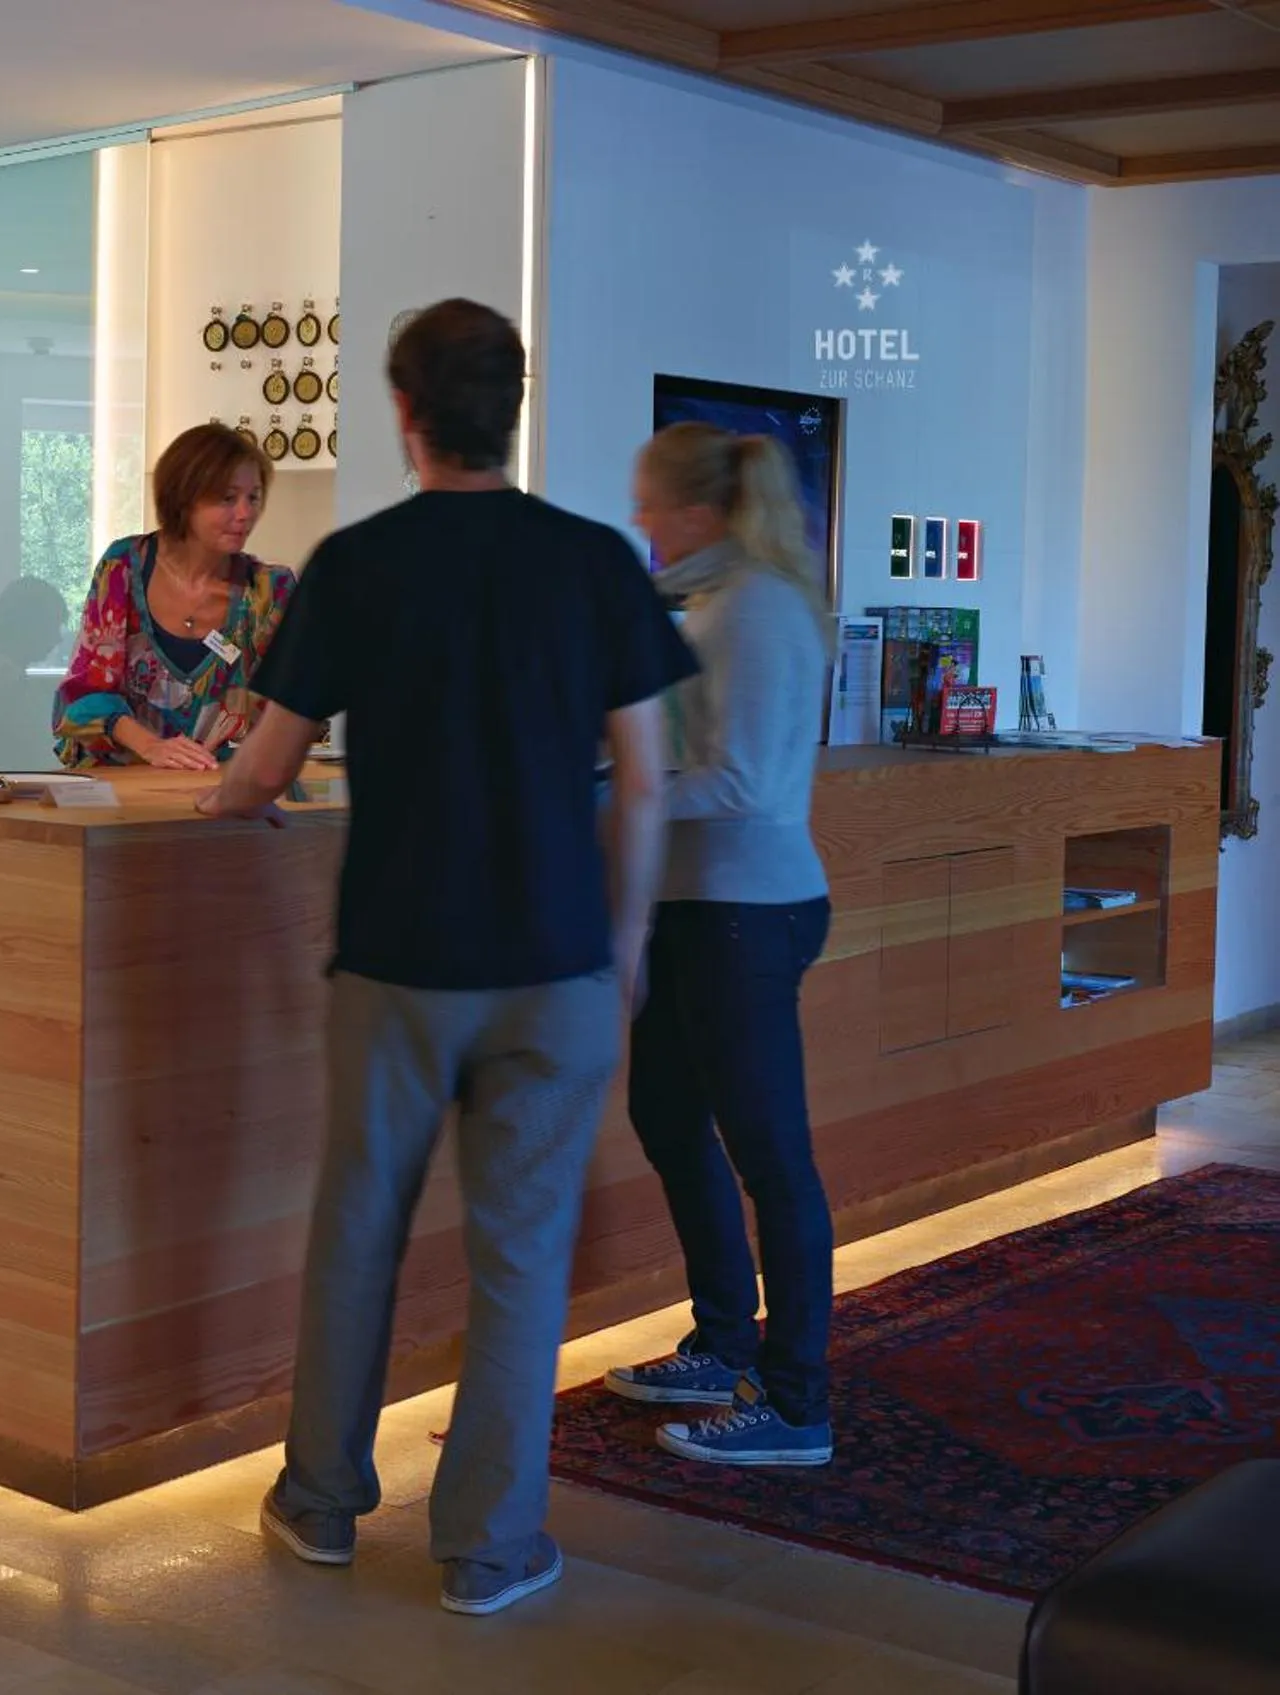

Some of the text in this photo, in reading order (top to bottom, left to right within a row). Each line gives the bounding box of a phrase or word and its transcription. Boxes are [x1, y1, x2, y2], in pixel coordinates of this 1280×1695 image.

[814, 328, 920, 361] HOTEL
[820, 369, 916, 389] ZUR SCHANZ
